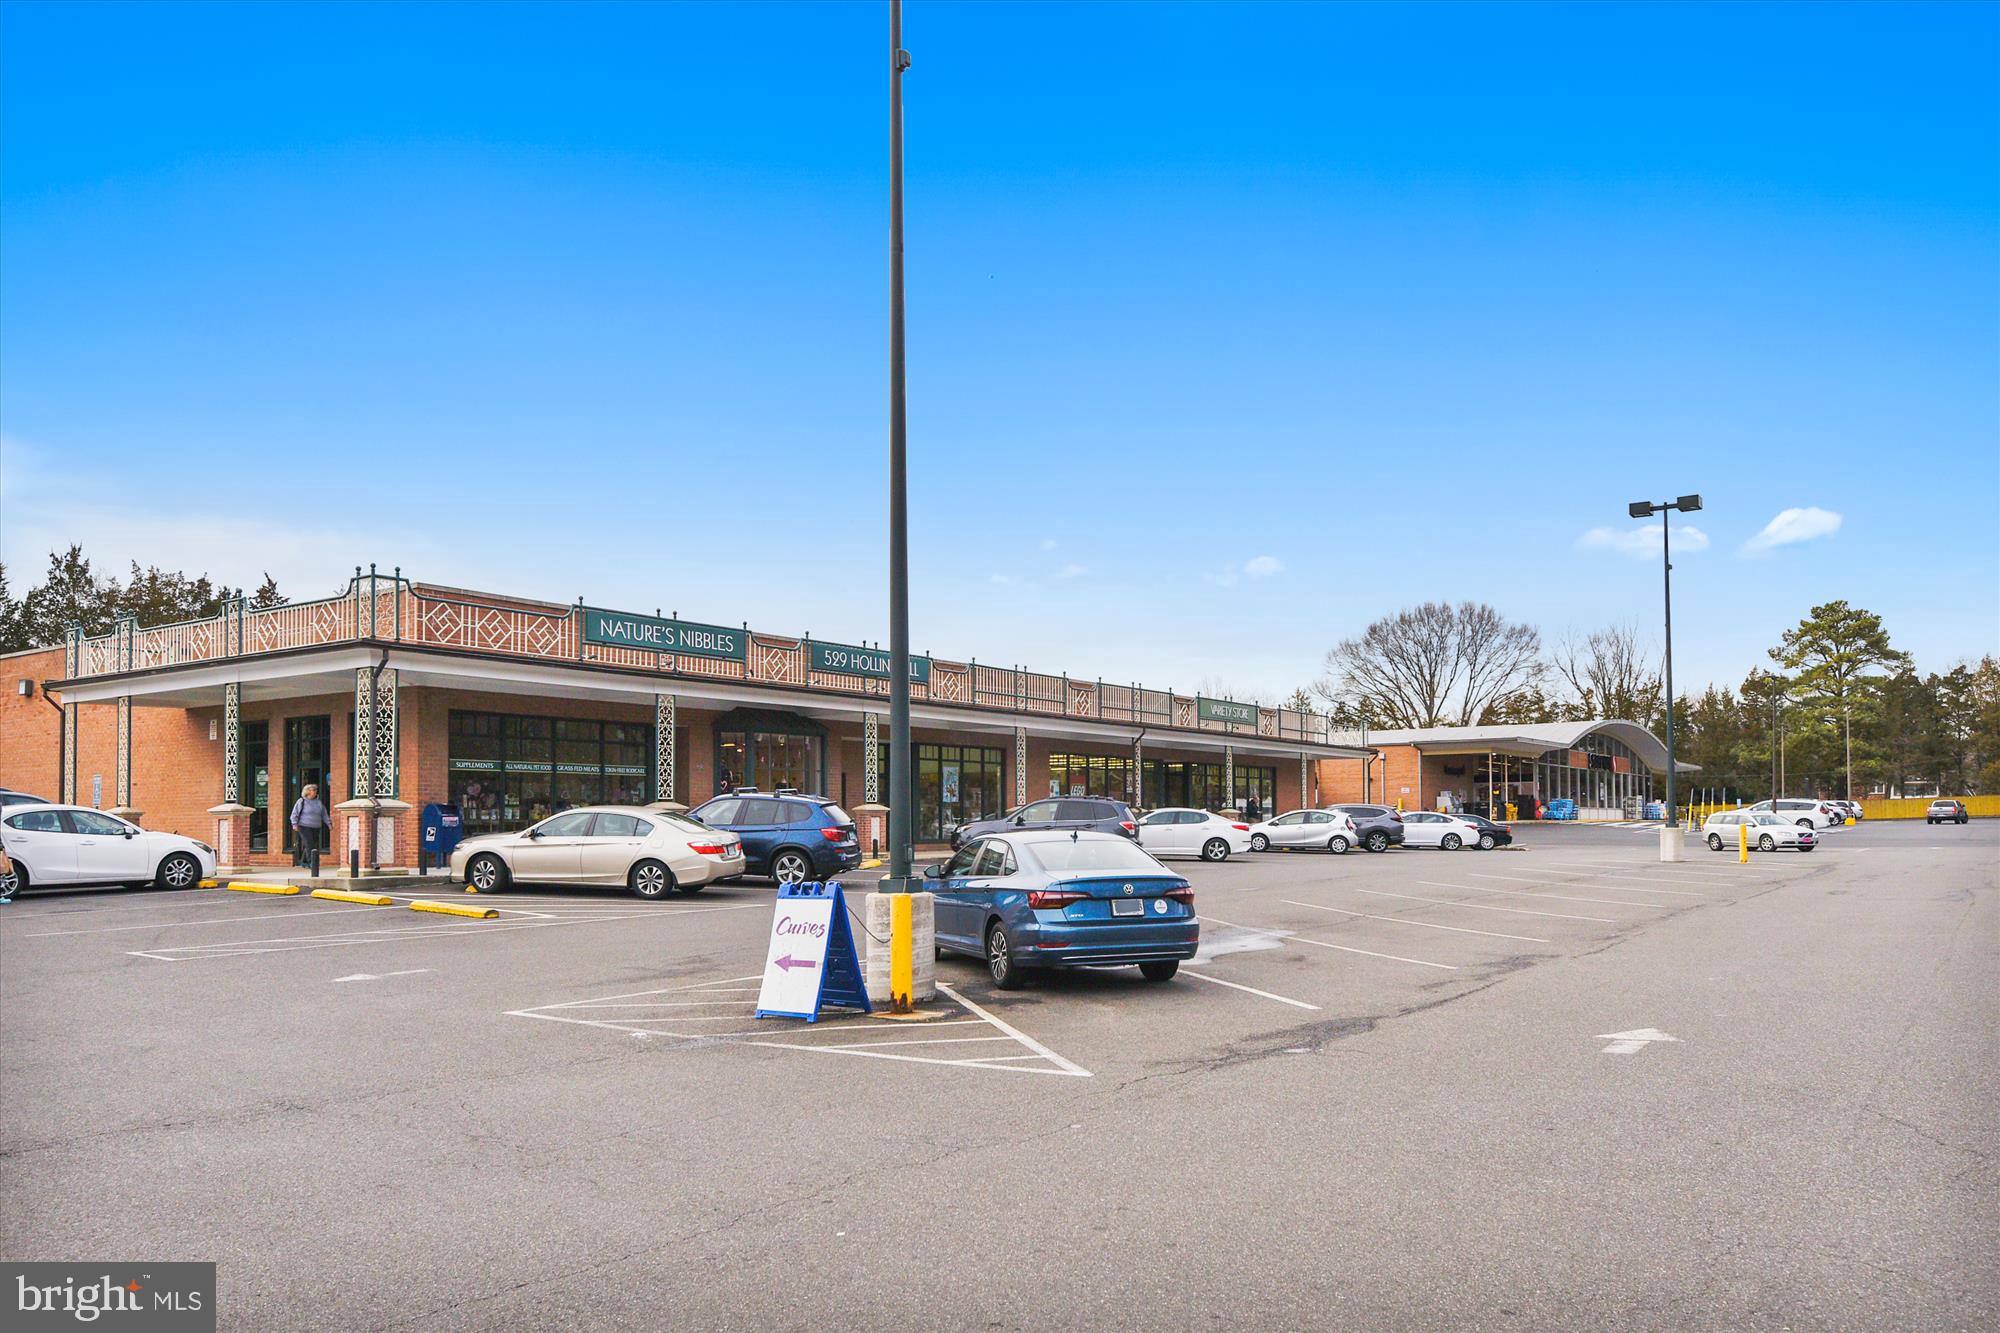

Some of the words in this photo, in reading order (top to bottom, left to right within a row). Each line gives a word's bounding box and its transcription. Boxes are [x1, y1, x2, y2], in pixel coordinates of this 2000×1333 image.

[600, 618, 675, 645] NATURE'S
[680, 630, 734, 652] NIBBLES
[824, 650, 848, 668] 529
[1210, 704, 1232, 717] VARIETY
[1232, 707, 1249, 720] STORE
[776, 915, 825, 938] Curves
